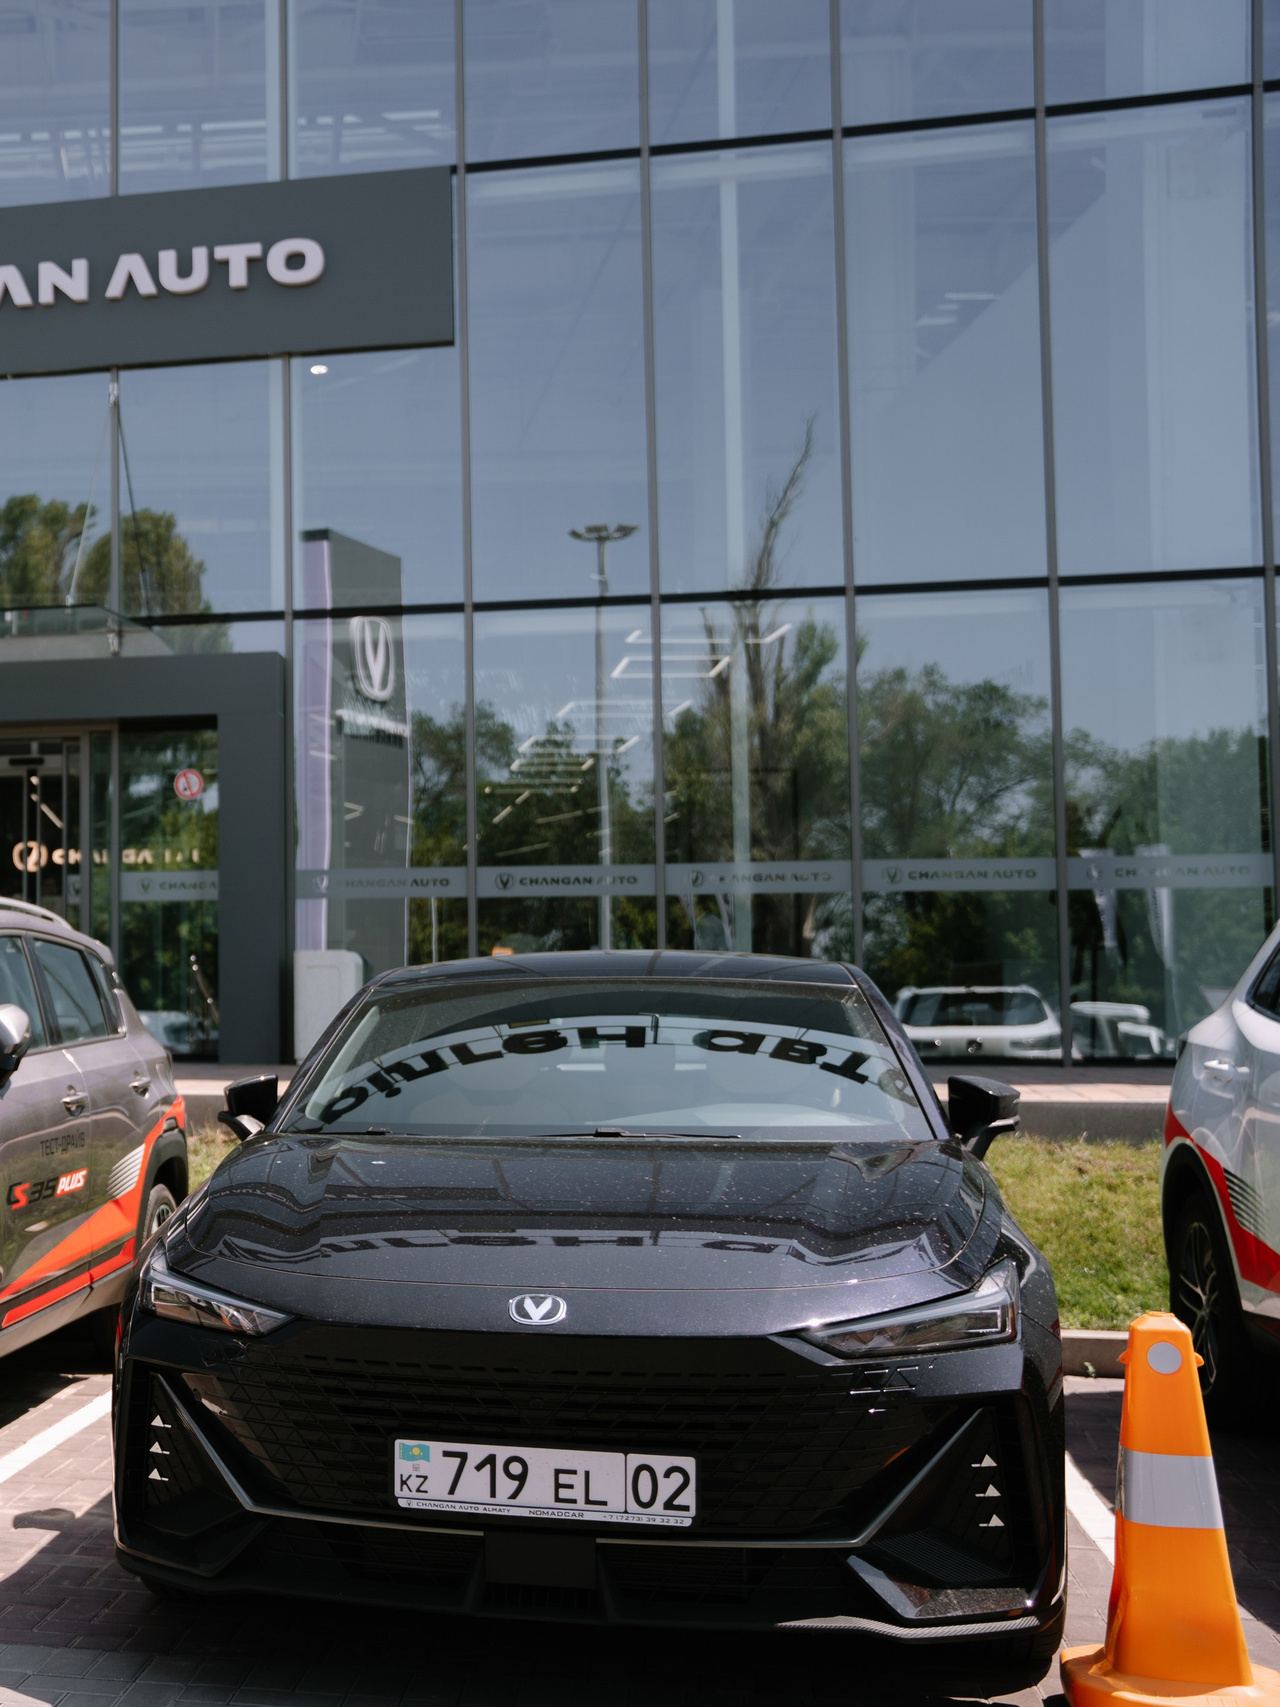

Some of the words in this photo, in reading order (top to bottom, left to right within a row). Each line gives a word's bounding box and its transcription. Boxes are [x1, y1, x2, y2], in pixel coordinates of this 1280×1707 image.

[105, 237, 325, 300] AUTO
[518, 875, 593, 886] CHANGAN
[907, 869, 988, 880] CHANGAN
[992, 867, 1038, 879] AUTO
[337, 877, 407, 888] HANGAN
[410, 876, 451, 888] AUTO
[40, 1130, 86, 1157] ТЕСТ-ДРАЙВ
[57, 1169, 87, 1195] PLUS
[400, 1474, 428, 1494] KZ
[442, 1450, 529, 1500] 719
[554, 1468, 608, 1506] EL
[631, 1463, 691, 1512] 02
[416, 1501, 456, 1510] CHANGAN
[528, 1509, 585, 1519] NOMADCAR
